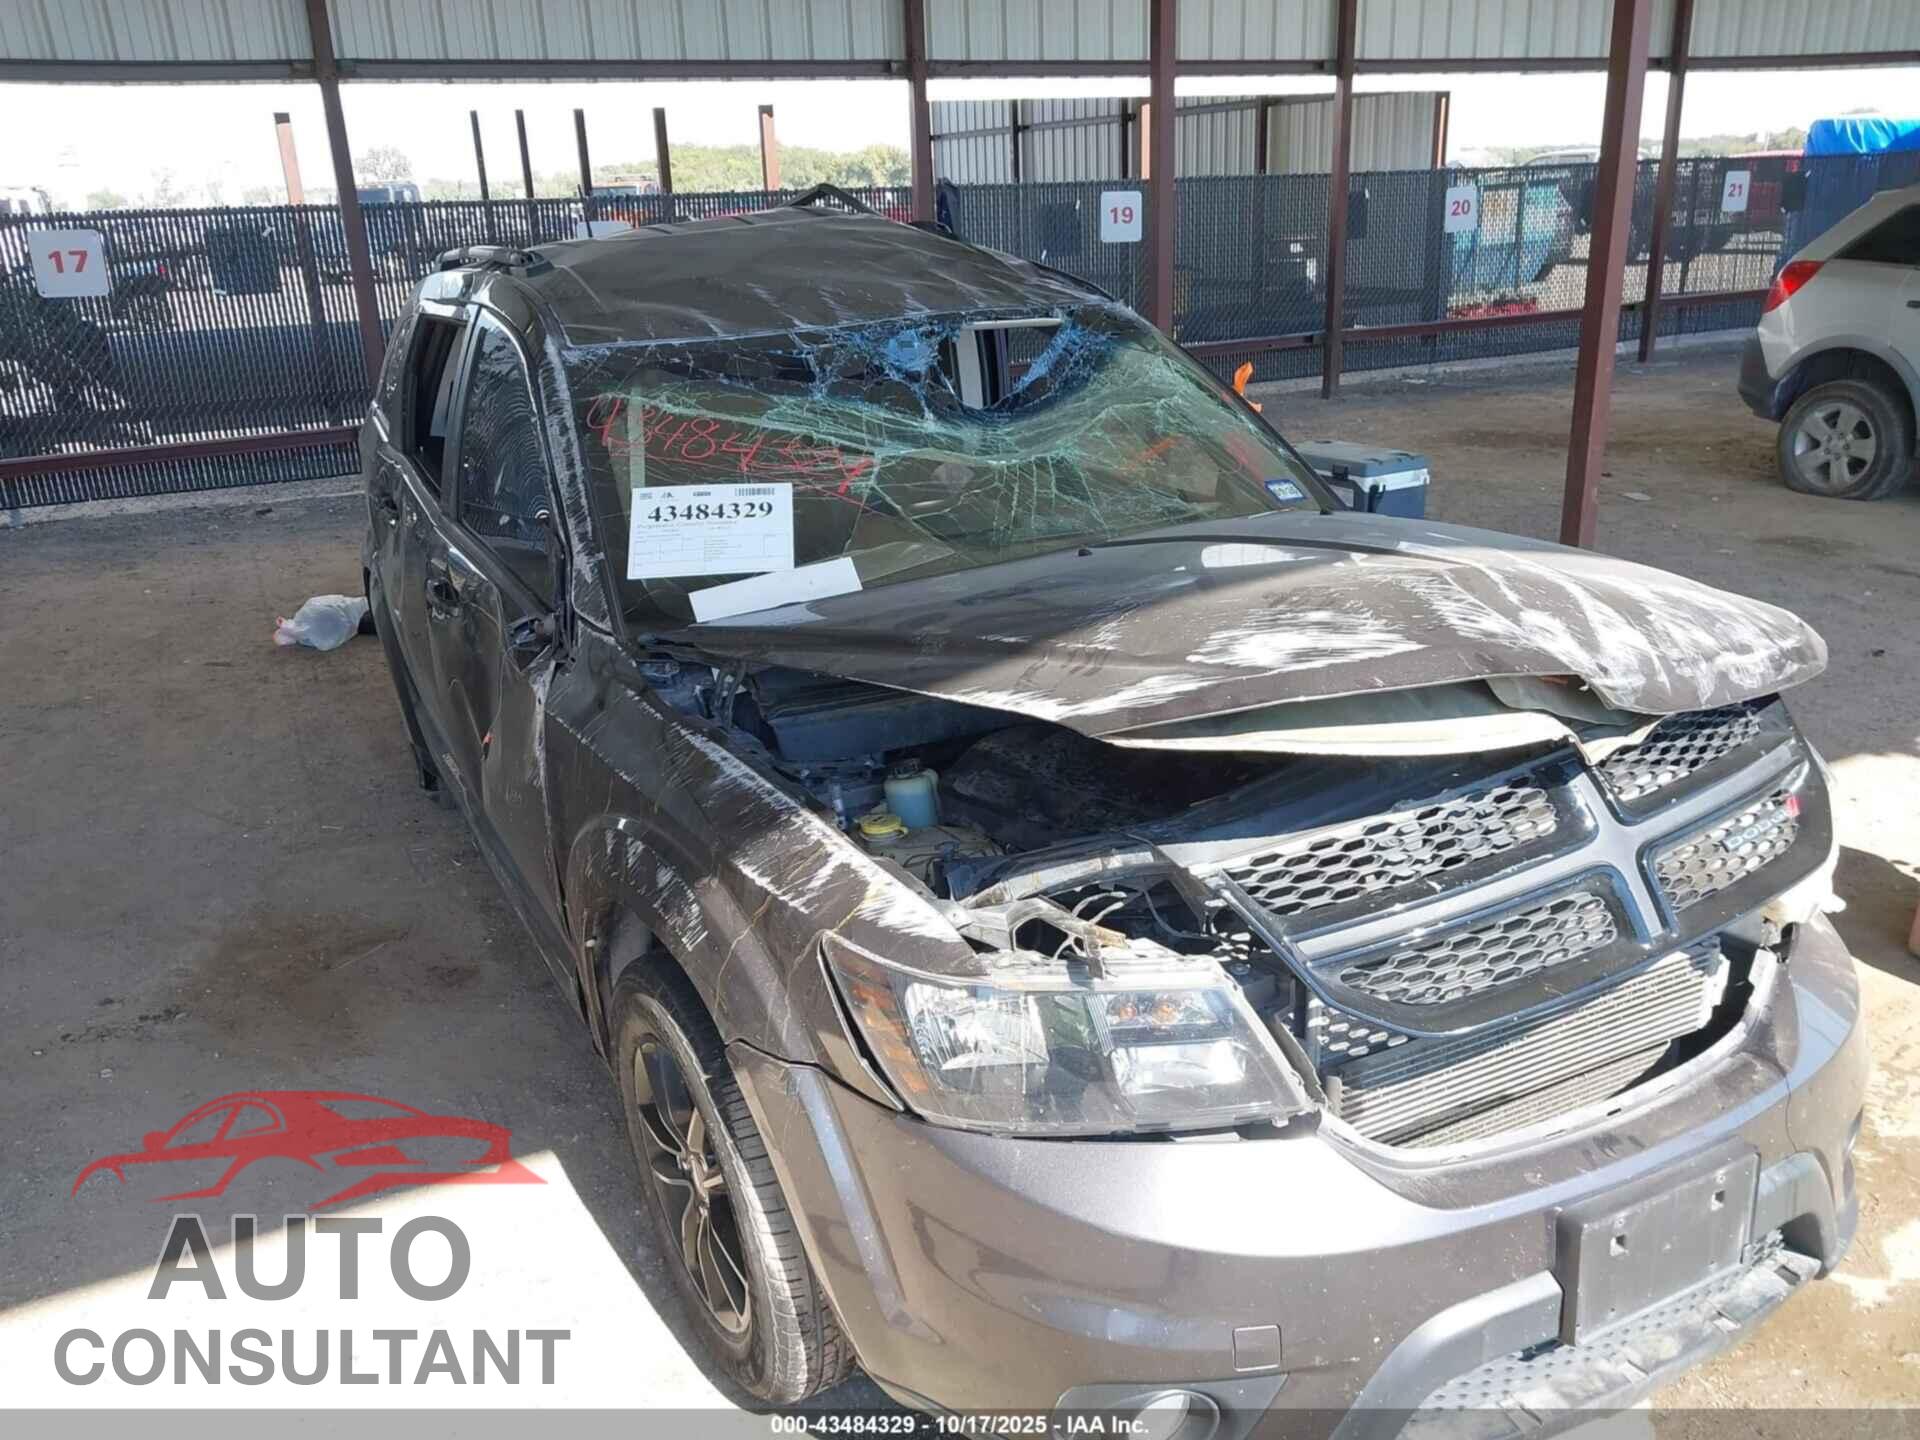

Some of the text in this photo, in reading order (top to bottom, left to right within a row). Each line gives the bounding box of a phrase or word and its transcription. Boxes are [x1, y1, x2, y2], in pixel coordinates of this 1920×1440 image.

[1727, 183, 1743, 198] 21
[1109, 206, 1134, 224] 19
[1450, 199, 1471, 216] 20
[47, 249, 88, 274] 17
[647, 501, 773, 522] 43484329
